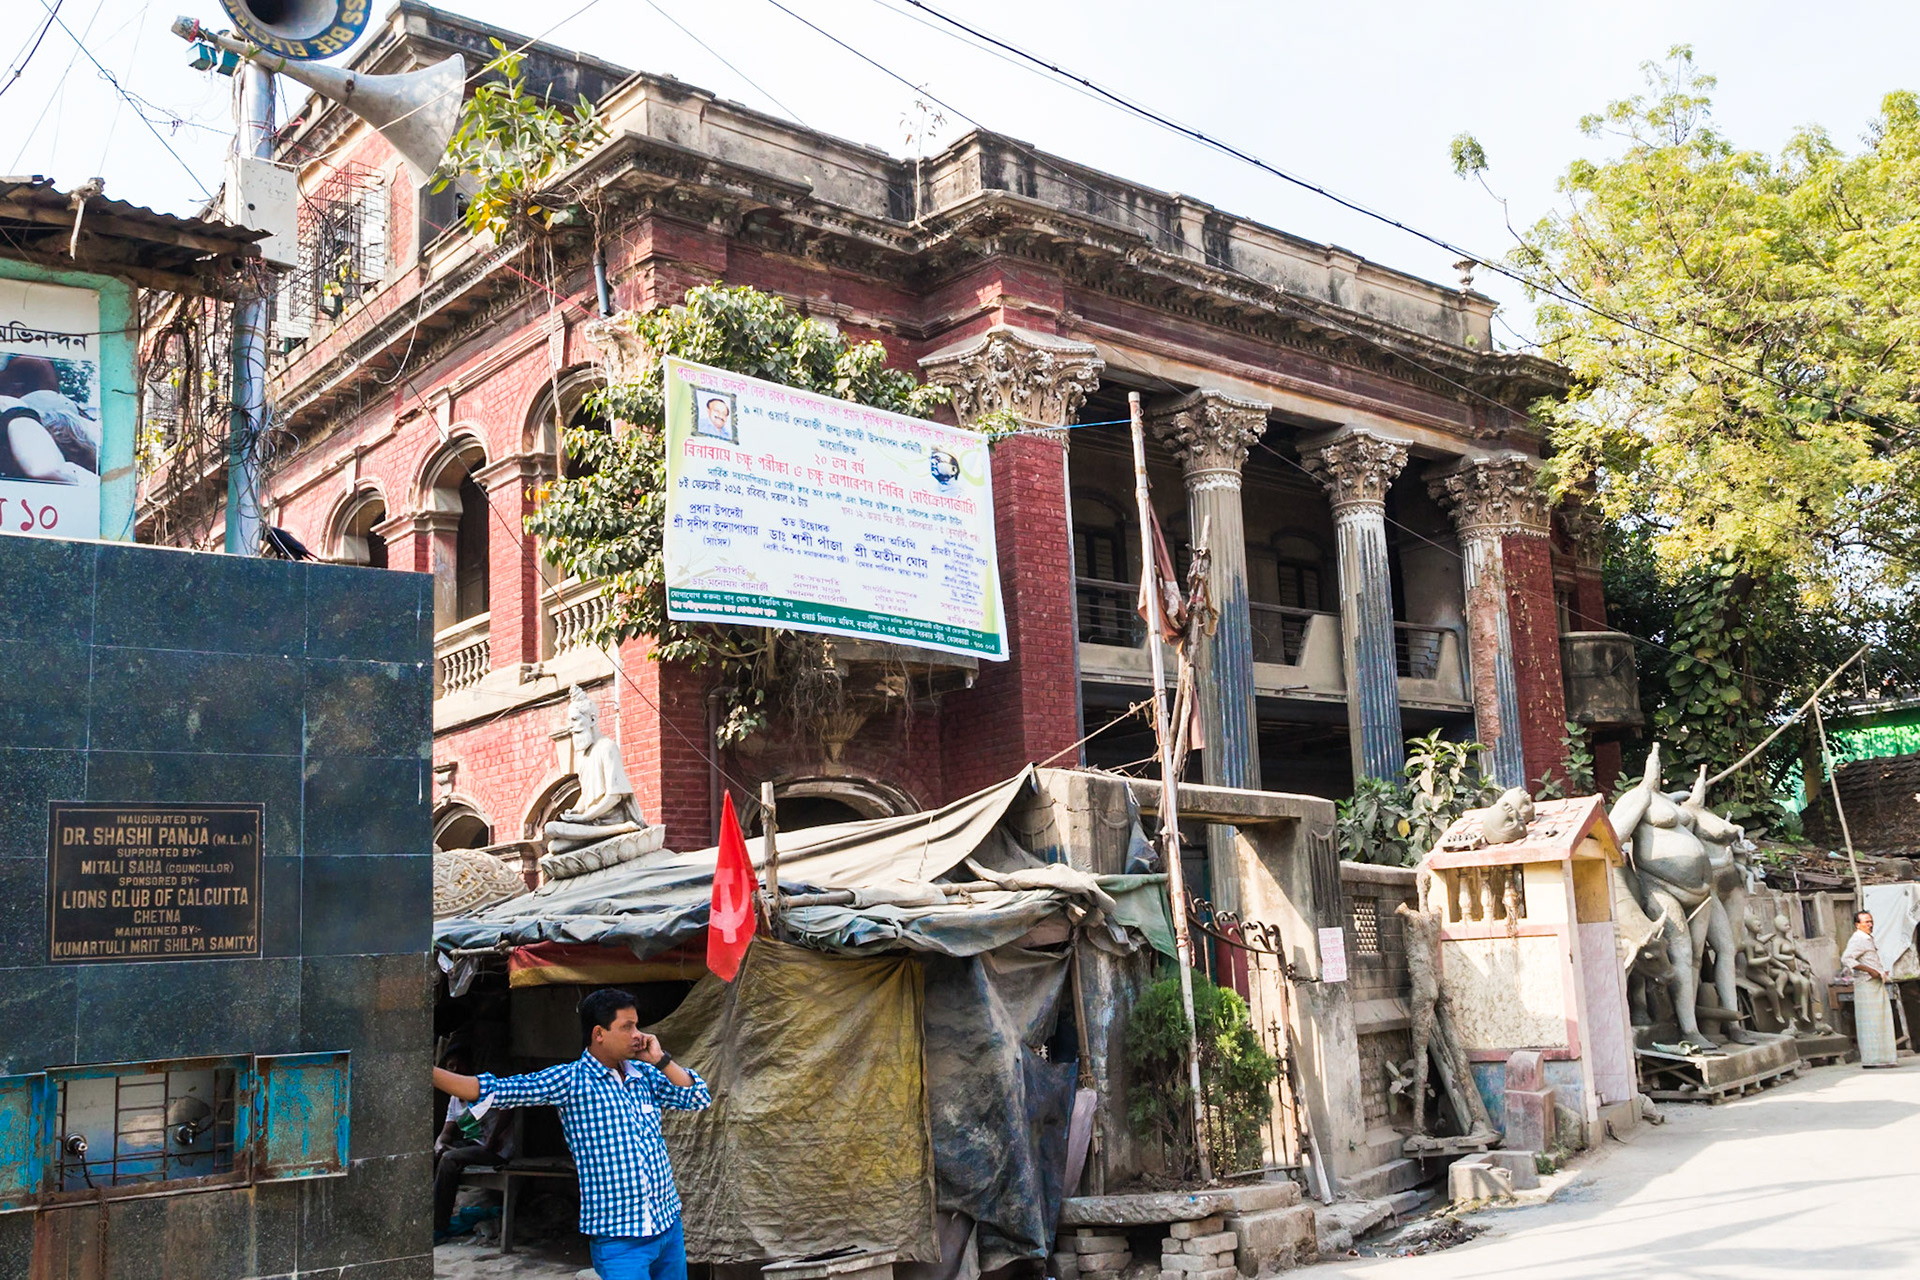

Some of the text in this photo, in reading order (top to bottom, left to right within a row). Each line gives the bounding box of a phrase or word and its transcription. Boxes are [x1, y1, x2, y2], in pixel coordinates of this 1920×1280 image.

[310, 26, 355, 55] BEE
[684, 438, 731, 462] বিনাব্যয়ে
[735, 452, 753, 471] চক্ষু
[758, 454, 789, 475] পরীক্ষা
[794, 466, 802, 478] ও
[807, 468, 824, 486] চক্ষু
[828, 472, 874, 494] অপারেশন
[878, 479, 904, 500] শিবির
[814, 453, 865, 475] ২০ তম বর্ষ
[20, 499, 58, 531] ১০
[689, 503, 743, 519] প্রধান উপদেষ্টা
[673, 514, 683, 528] শ্রী
[781, 516, 796, 527] শুভ
[703, 535, 731, 548] (সাংসদ)
[769, 528, 786, 542] ডাঃ
[792, 531, 813, 547] শশী
[864, 532, 916, 550] প্রধান অতিথি
[854, 542, 928, 569] শ্রী অতীন ঘোষ
[714, 565, 747, 576] সভাপতি
[117, 815, 187, 824] INAUGURATED
[63, 827, 253, 846] DR. SHASHI PANJA (M.L.A)
[117, 849, 179, 858] SUPPORTED
[81, 860, 234, 874] MITALI SAHA (COUNCILLOR)
[119, 877, 177, 886] SPONSORED
[62, 887, 248, 909] LIONS CLUB OF CALCUTTA
[134, 910, 180, 924] CHETNA
[115, 926, 177, 937] MAINTAINED
[55, 936, 254, 956] KUMARTULI MRIT SHILPA SAMITY
